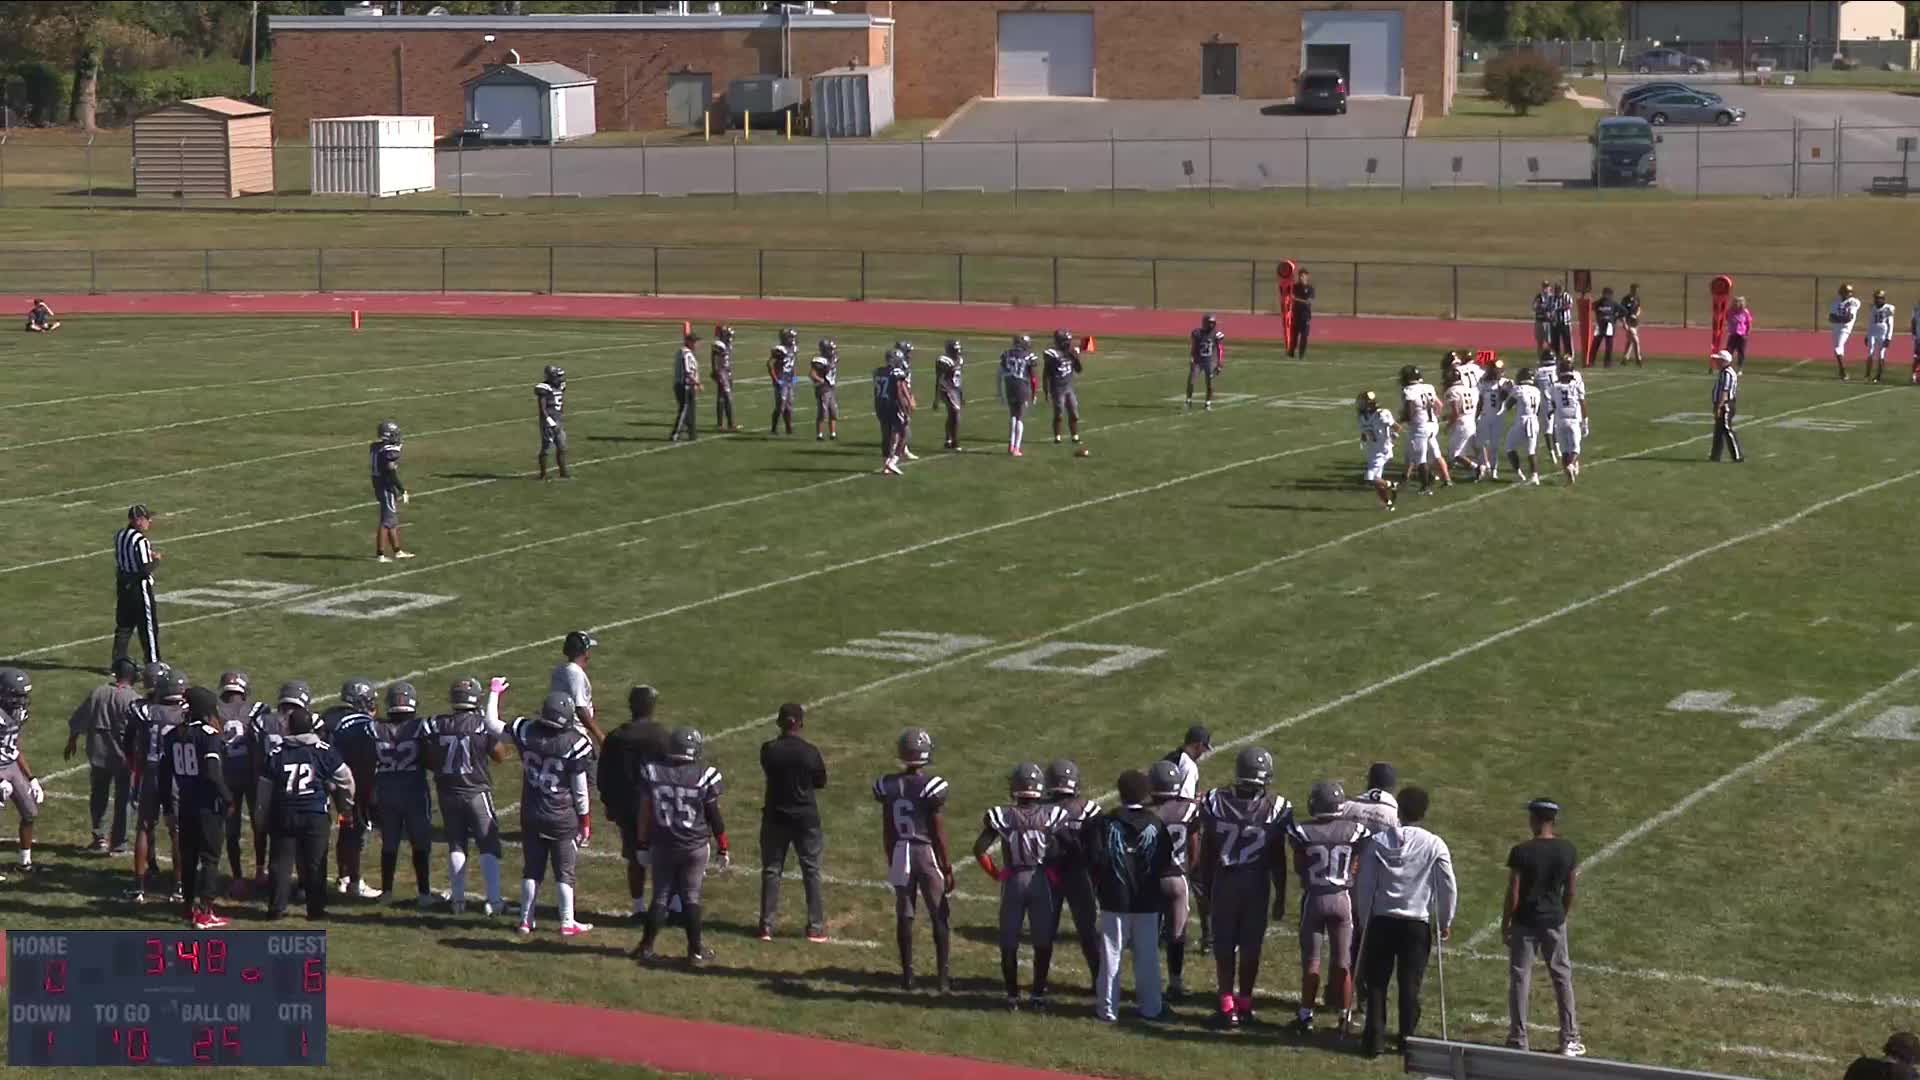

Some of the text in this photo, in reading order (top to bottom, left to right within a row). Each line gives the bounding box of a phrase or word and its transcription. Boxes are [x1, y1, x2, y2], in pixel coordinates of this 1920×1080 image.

[172, 741, 199, 776] 88
[439, 735, 473, 775] 71
[283, 763, 315, 795] 72
[893, 799, 915, 839] 6
[1216, 821, 1266, 866] 72
[1305, 845, 1353, 887] 20
